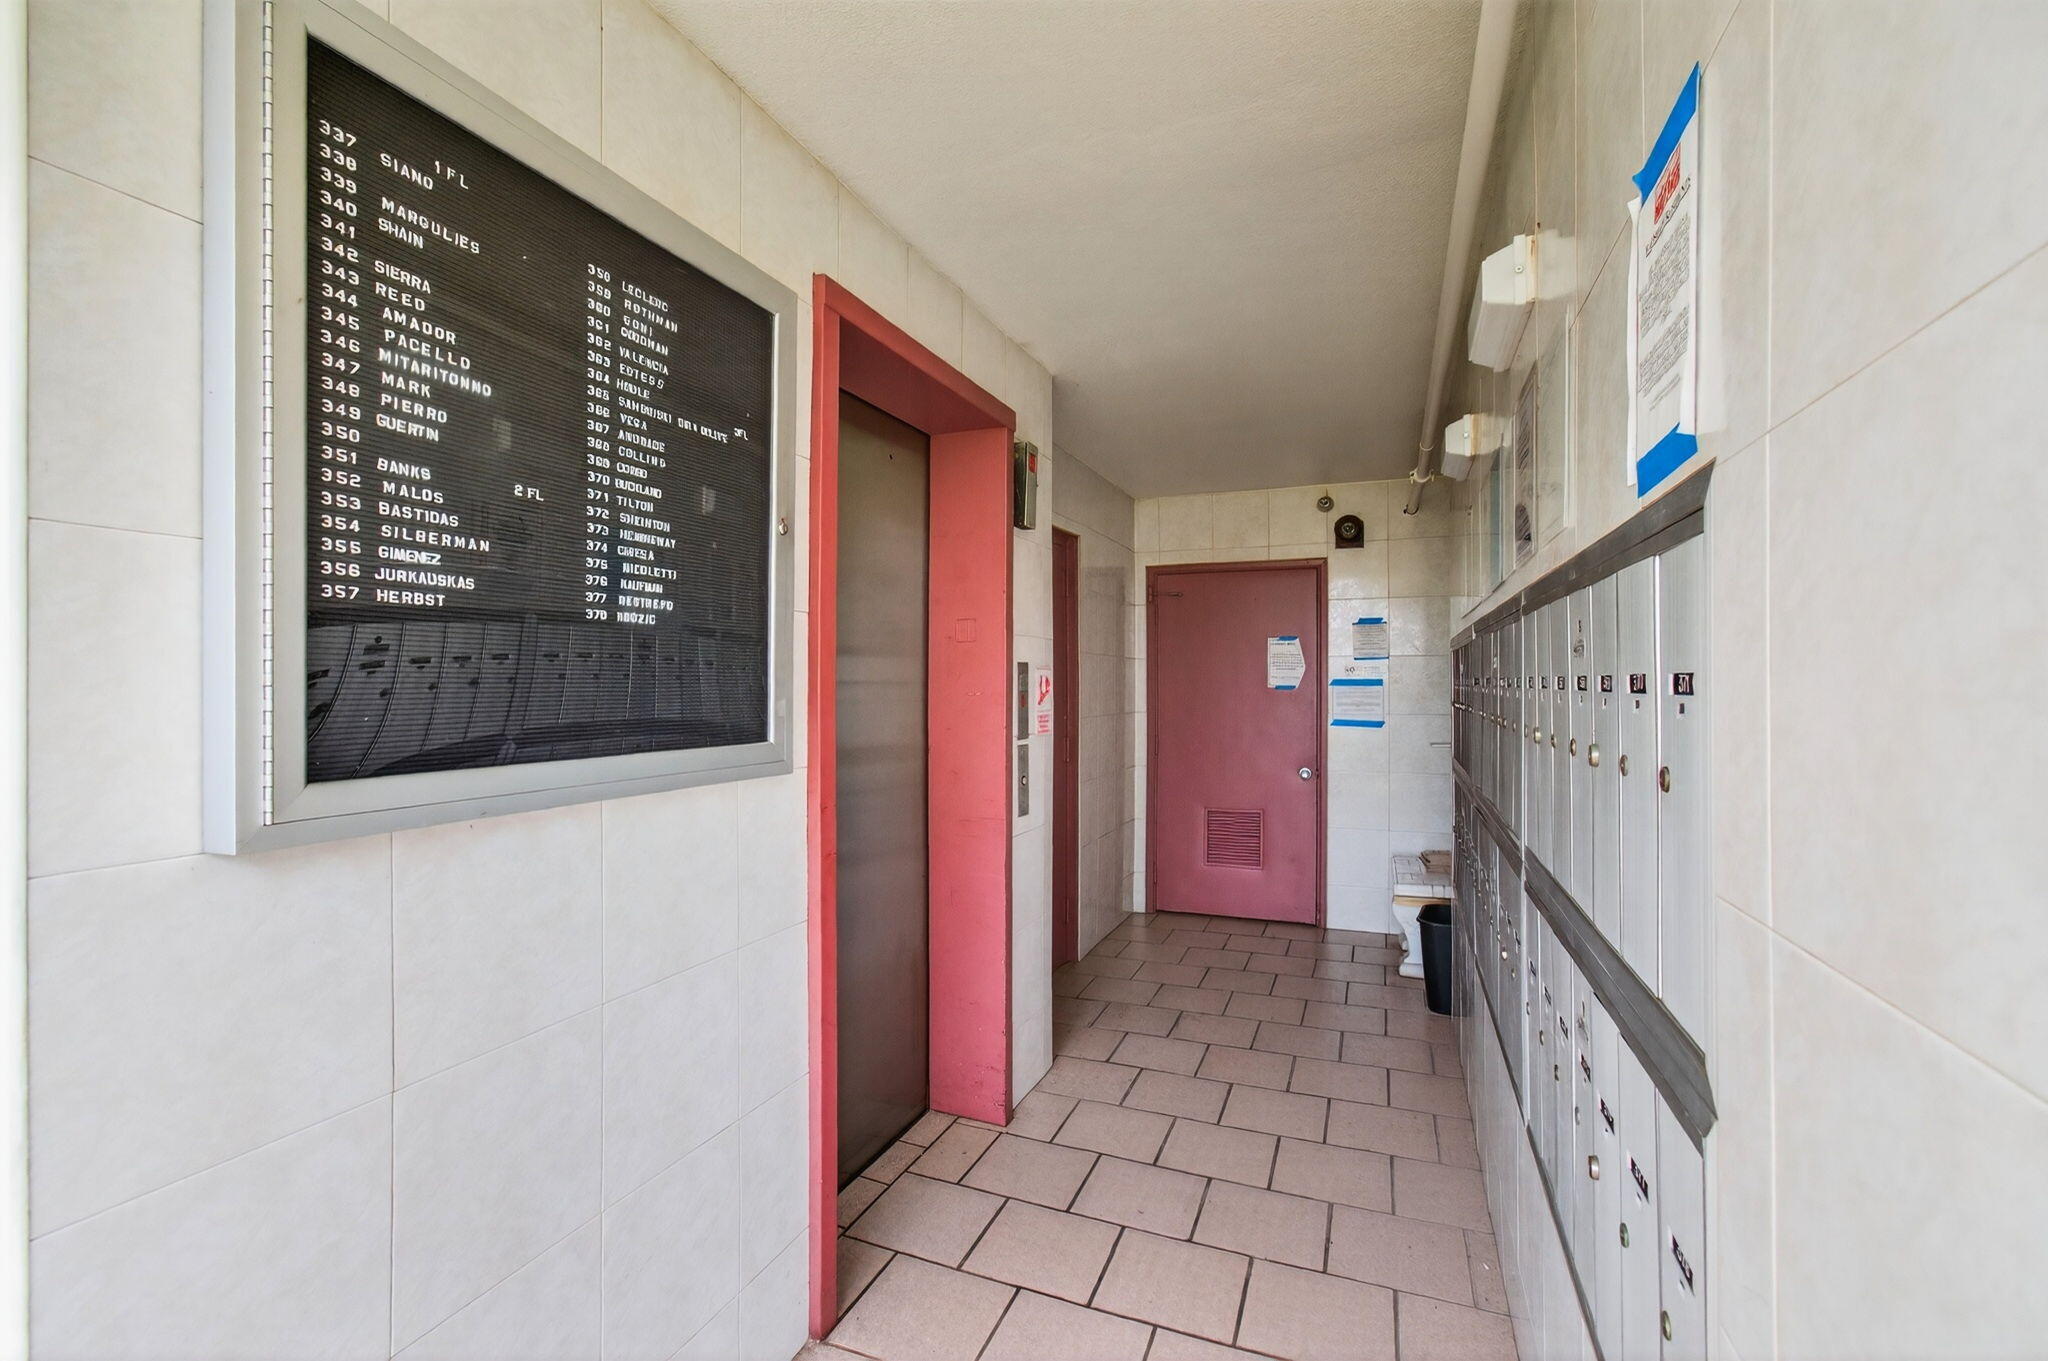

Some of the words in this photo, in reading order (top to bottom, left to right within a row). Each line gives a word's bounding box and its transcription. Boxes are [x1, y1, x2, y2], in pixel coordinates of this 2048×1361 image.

[319, 120, 357, 147] 337
[380, 152, 433, 190] SIANO
[319, 143, 357, 171] 338
[320, 166, 357, 194] 339
[381, 196, 480, 254] MARGULIES
[320, 190, 357, 217] 340
[378, 217, 424, 249] SHAIN
[320, 213, 356, 240] 341
[321, 237, 360, 263] 342
[374, 260, 431, 294] SIERRA
[321, 260, 360, 286] 343
[375, 281, 426, 312] REED
[321, 283, 359, 308] 344
[382, 307, 457, 345] AMADOR
[624, 299, 678, 333] ROTHMAN
[320, 329, 361, 354] 346
[321, 306, 360, 331] 345
[384, 329, 471, 370] PACELLO
[587, 333, 612, 351] 362
[619, 346, 669, 376] VALENCIA
[321, 352, 361, 375] 347
[381, 371, 432, 398] MARK
[321, 376, 360, 398] 348
[380, 393, 447, 423] PIERRO
[321, 399, 361, 420] 349
[376, 413, 440, 442] GUERTIN
[321, 422, 360, 443] 350
[321, 445, 357, 464] 351
[377, 457, 432, 481] BANKS
[587, 471, 610, 485] 370
[321, 468, 361, 487] 352
[382, 480, 444, 504] MALOS
[514, 484, 523, 496] 2
[527, 487, 544, 501] FL
[587, 488, 609, 503] 371
[321, 491, 361, 510] 353
[378, 501, 459, 527] BASTIDAS
[586, 506, 610, 520] 372
[321, 515, 360, 533] 354
[380, 524, 490, 552] SILBERMAN
[586, 540, 608, 553] 374
[587, 523, 609, 536] 373
[321, 537, 362, 554] 355
[378, 546, 442, 565] GIMENEZ
[586, 557, 608, 570] 375
[320, 560, 361, 578] 356
[374, 567, 475, 590] JURKAUSKAS
[320, 584, 360, 600] 357
[376, 588, 446, 607] HERBST
[585, 592, 607, 604] 377
